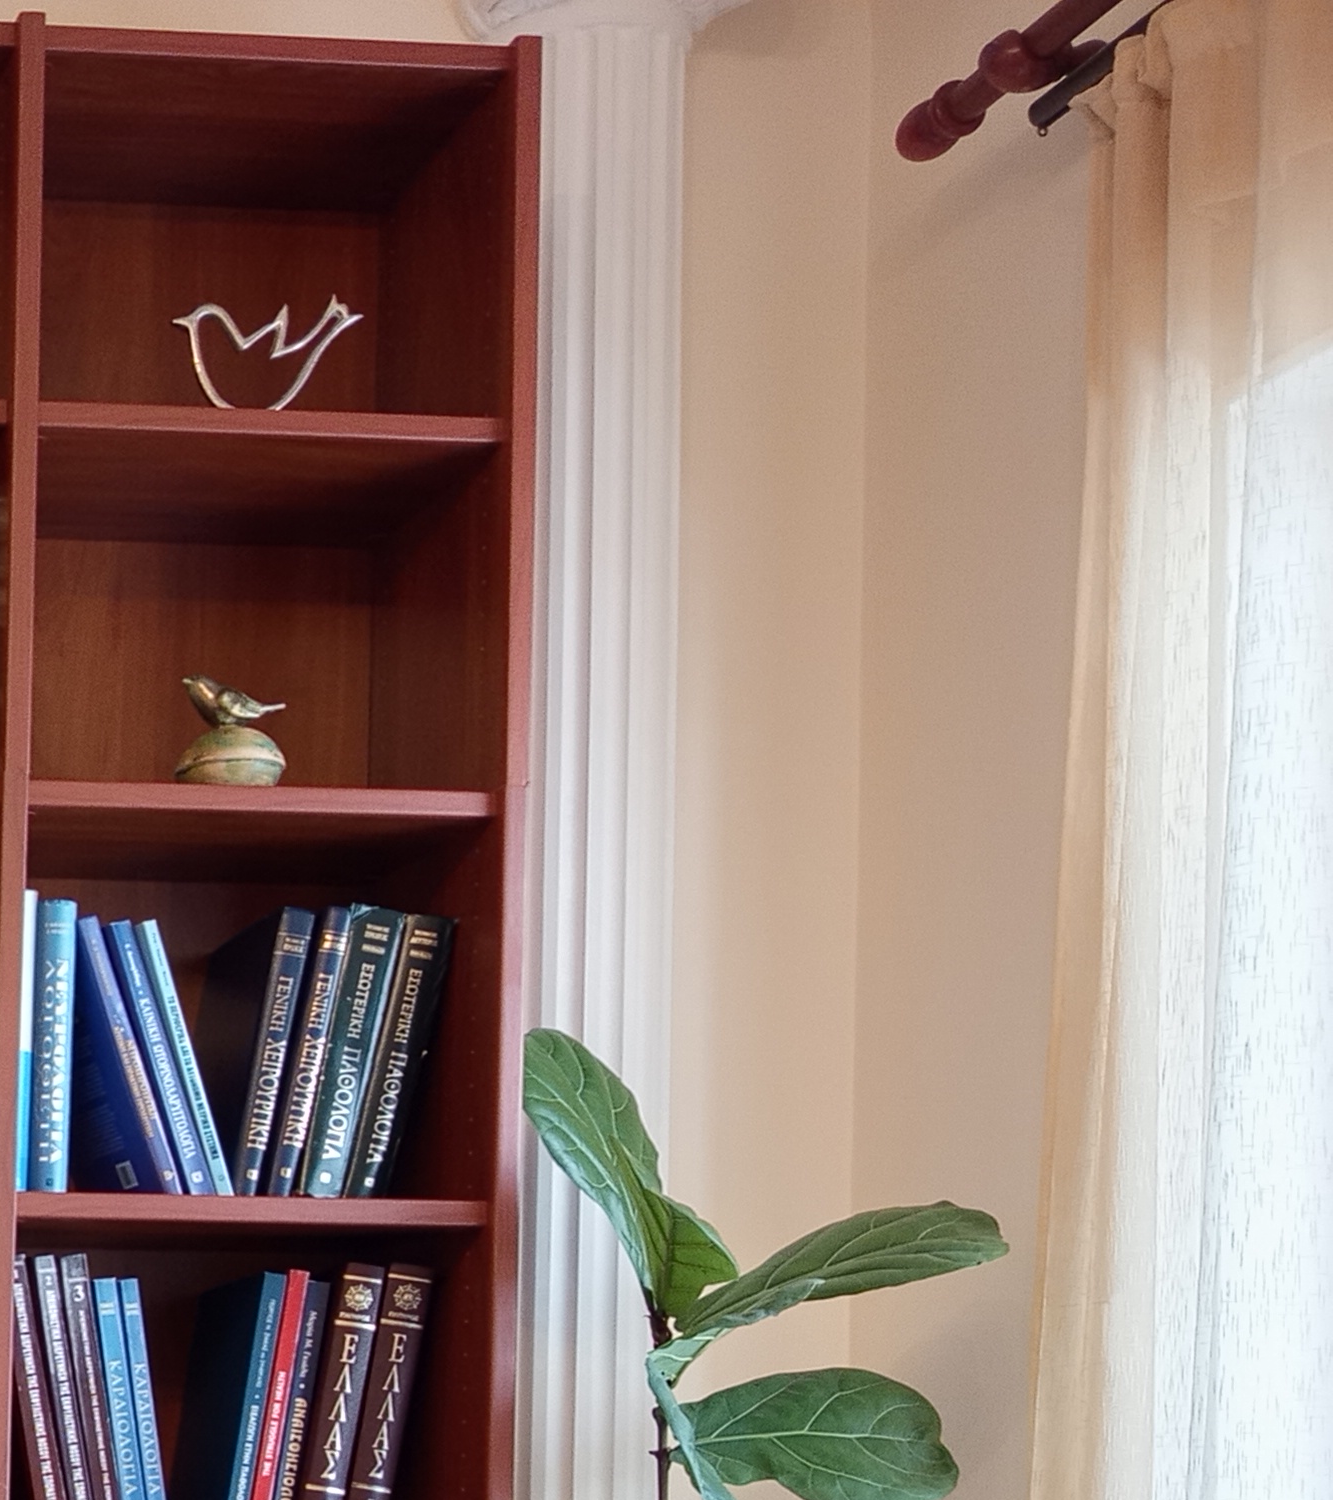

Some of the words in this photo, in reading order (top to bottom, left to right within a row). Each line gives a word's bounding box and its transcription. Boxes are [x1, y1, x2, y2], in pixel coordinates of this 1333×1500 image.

[267, 975, 294, 1033] ΓΕΝΙΚΗ
[307, 971, 334, 1030] ΓΕΝΙΚΗ
[346, 962, 377, 1040] ΕΣΩΤΕΡΙΚΗ
[393, 967, 424, 1044] ΕΣΩΤΕΡΙΚΗ
[246, 1037, 289, 1152] ΧΕΙΡΟΥΡΓΙΚΗ
[282, 1033, 328, 1149] ΧΕΙΡΟΥΡΓΙΚΗ
[320, 1045, 363, 1160] ΠΑΘΟΛΟΓΙΑ
[365, 1050, 408, 1165] ΠΑΘΟΛΟΓΙΑ
[72, 1285, 85, 1303] 3
[107, 1359, 137, 1497] ΚΑΡΔΙΟΛΟΓΙΑ
[133, 1362, 161, 1495] ΚΑΡΔΙΟΛΟΓΙΑ
[319, 1332, 360, 1481] ΕΛΛΑΣ
[367, 1332, 408, 1480] ΕΛΛΑΣ
